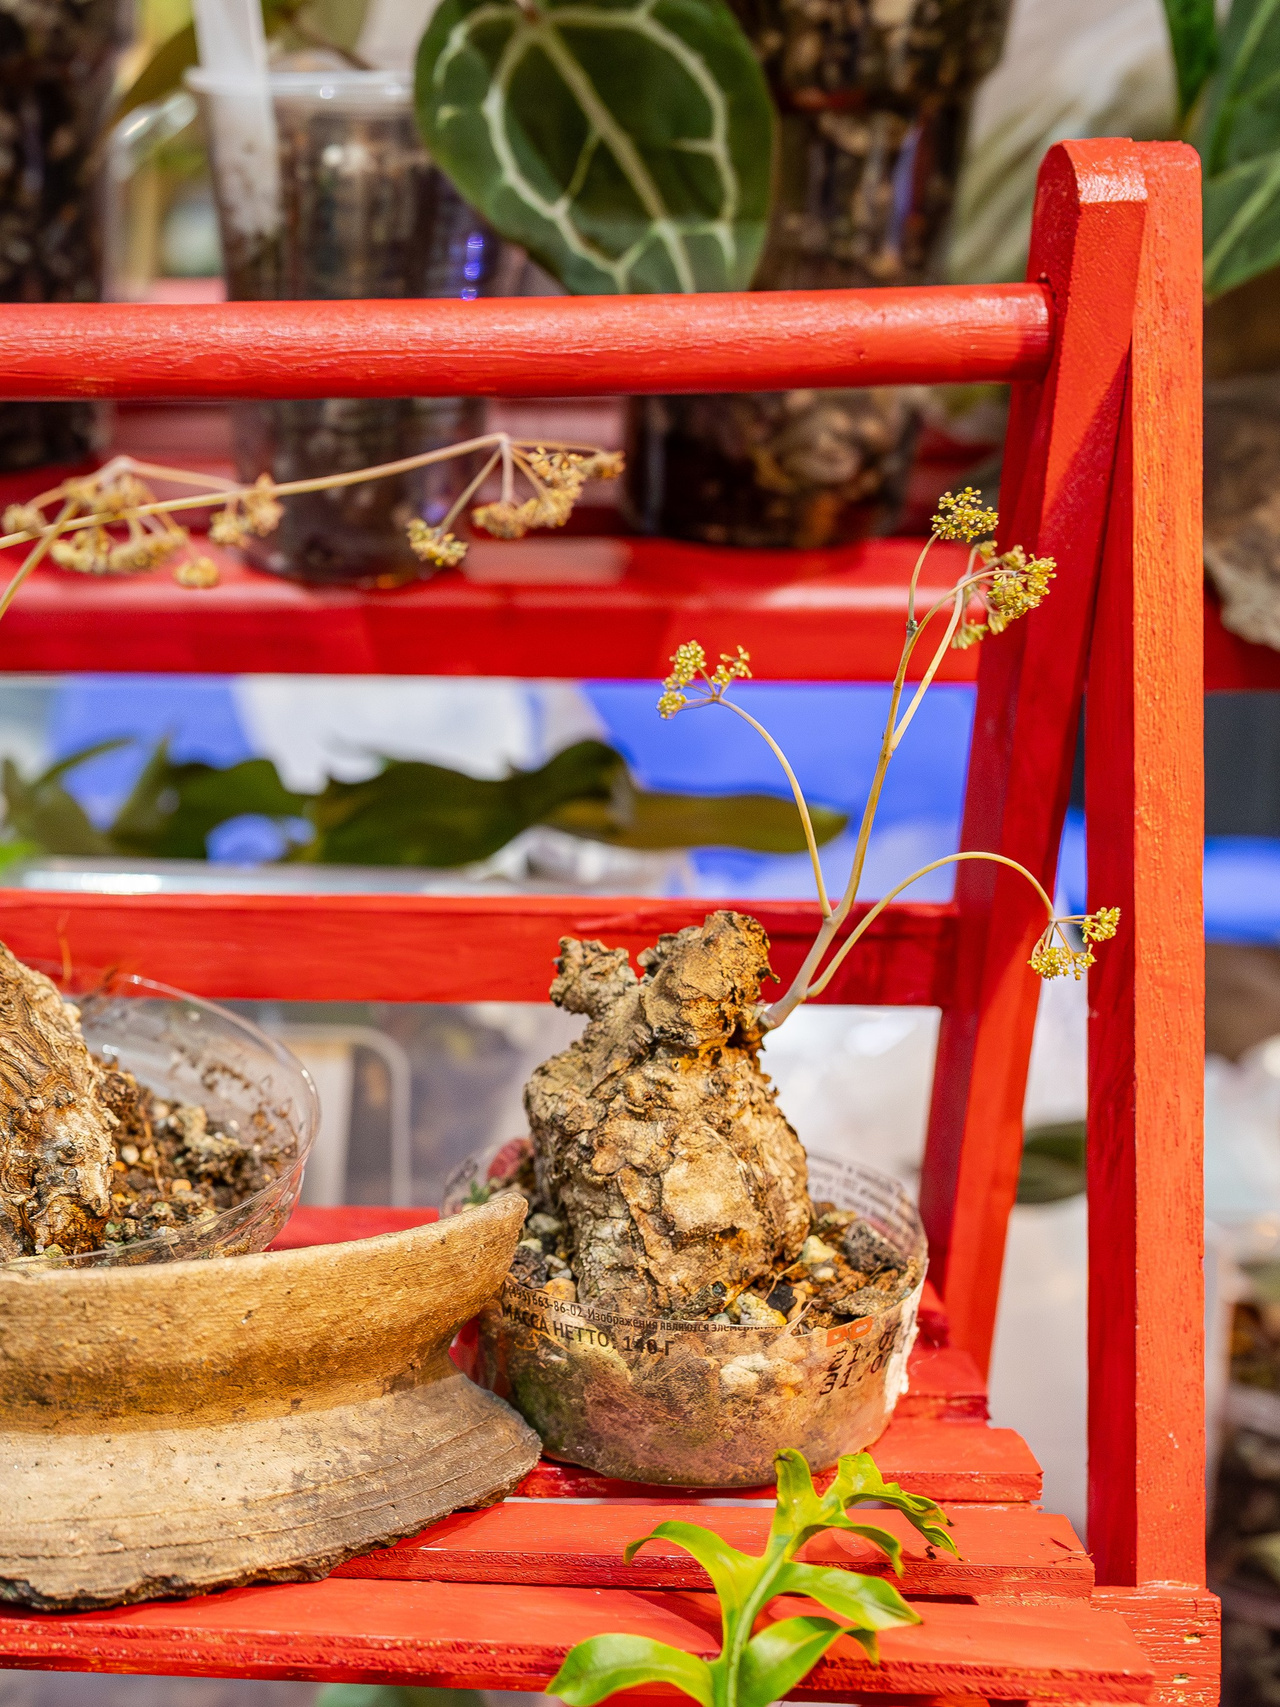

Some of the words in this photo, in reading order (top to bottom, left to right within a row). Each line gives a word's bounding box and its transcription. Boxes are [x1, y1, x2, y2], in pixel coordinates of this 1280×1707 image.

[502, 1303, 550, 1335] МАССА
[587, 1308, 658, 1331] Изображения
[660, 1321, 709, 1333] являются
